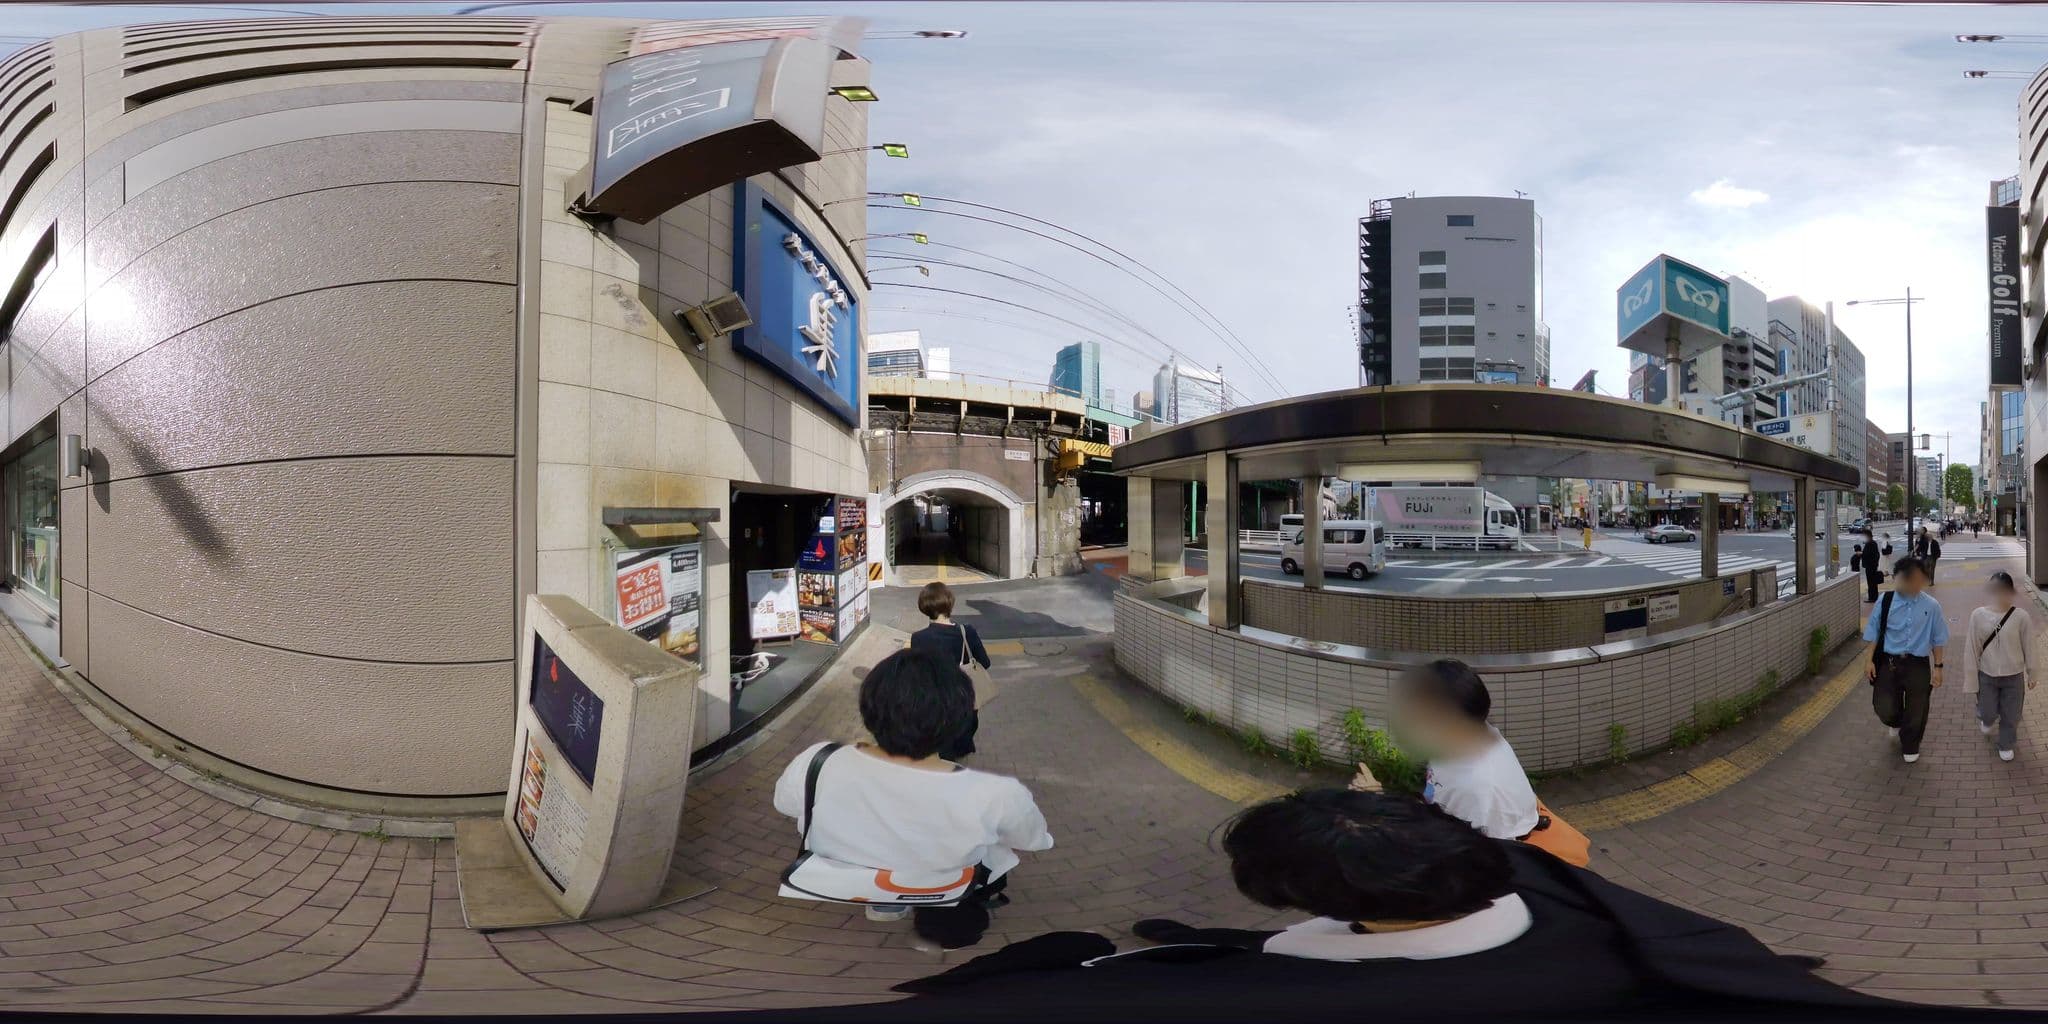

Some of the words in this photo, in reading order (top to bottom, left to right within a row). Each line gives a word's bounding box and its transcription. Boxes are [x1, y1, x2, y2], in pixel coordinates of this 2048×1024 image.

[1992, 235, 2006, 272] Victoria
[1993, 274, 2018, 316] Golf
[798, 292, 840, 378] 集
[1993, 319, 2004, 357] Premium
[620, 568, 659, 593] ご宴会
